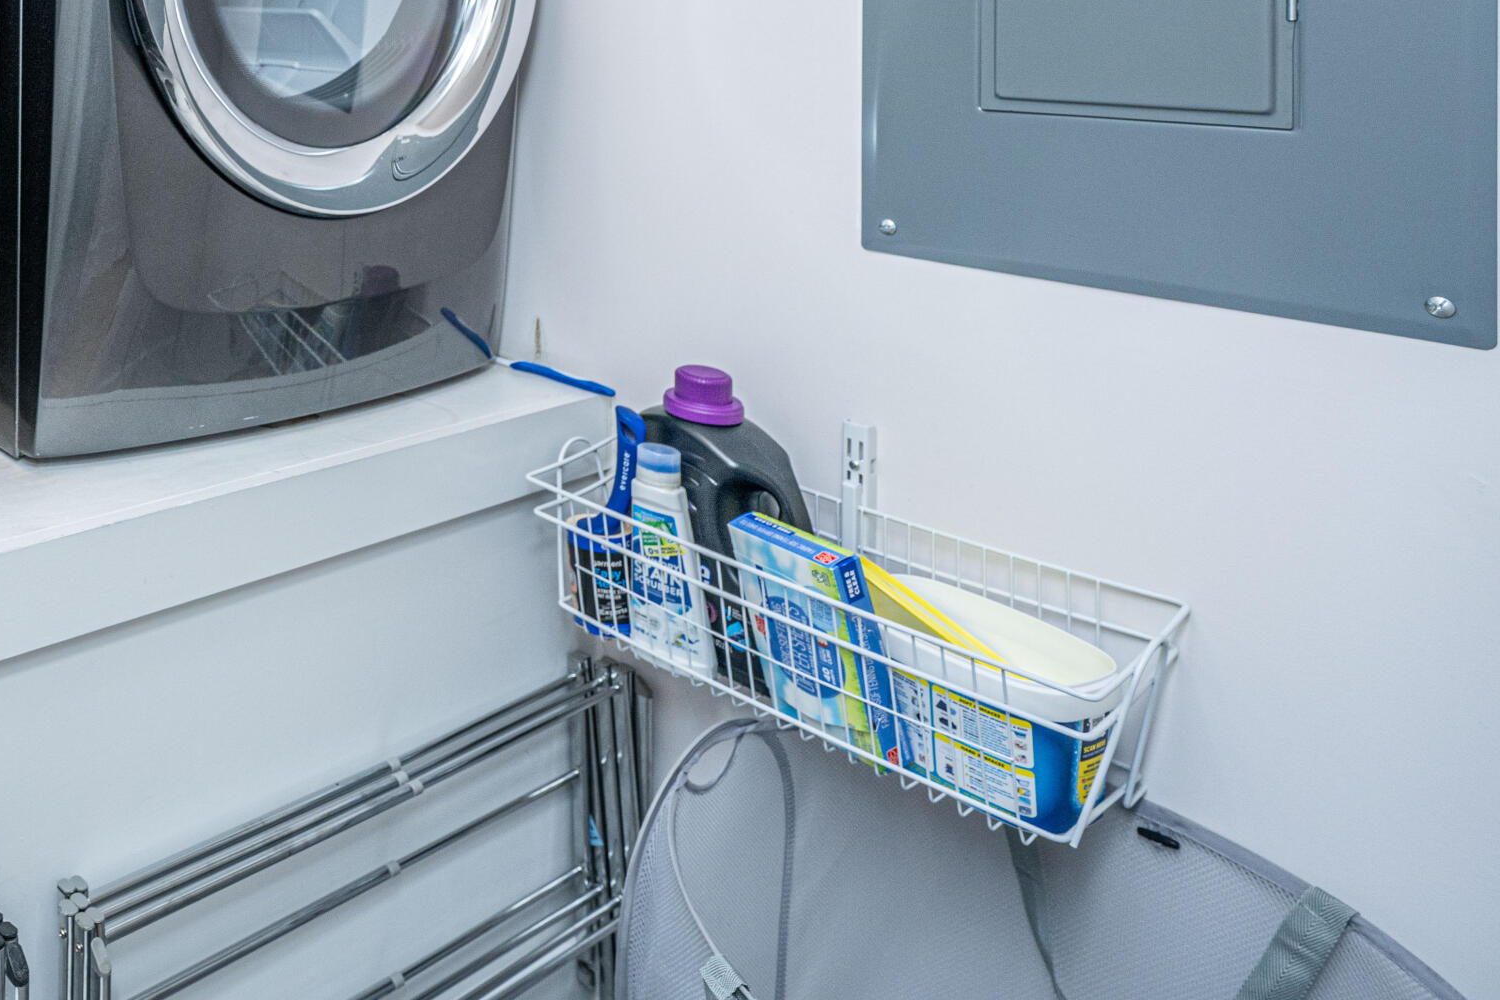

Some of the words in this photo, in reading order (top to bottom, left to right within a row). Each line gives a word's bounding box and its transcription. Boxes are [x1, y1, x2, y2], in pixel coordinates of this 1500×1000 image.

[620, 452, 631, 491] evercare
[846, 580, 855, 599] FREE
[849, 569, 860, 595] CLEAR
